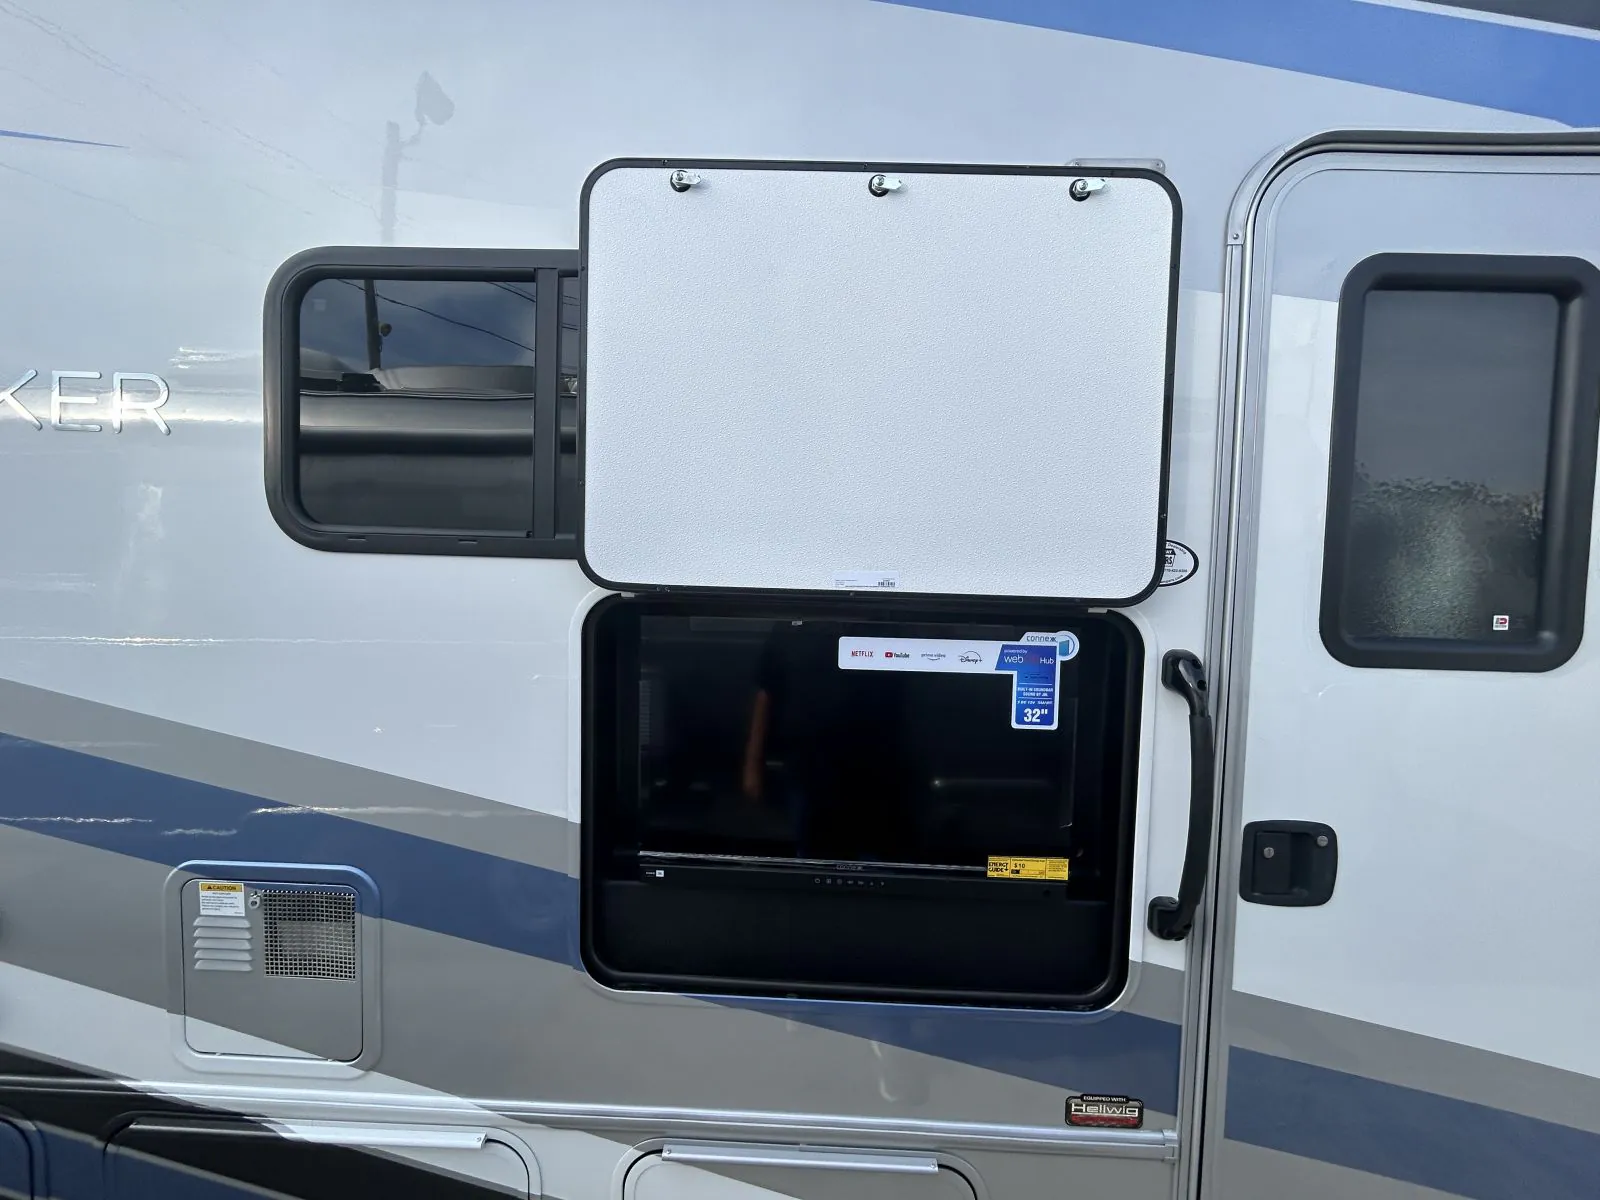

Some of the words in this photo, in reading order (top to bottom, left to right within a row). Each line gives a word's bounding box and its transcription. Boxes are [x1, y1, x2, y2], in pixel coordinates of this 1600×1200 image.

[851, 650, 874, 658] NETFLIX
[1039, 656, 1055, 665] Hub
[1023, 708, 1049, 723] 32"
[1071, 1102, 1139, 1117] Hellwig
